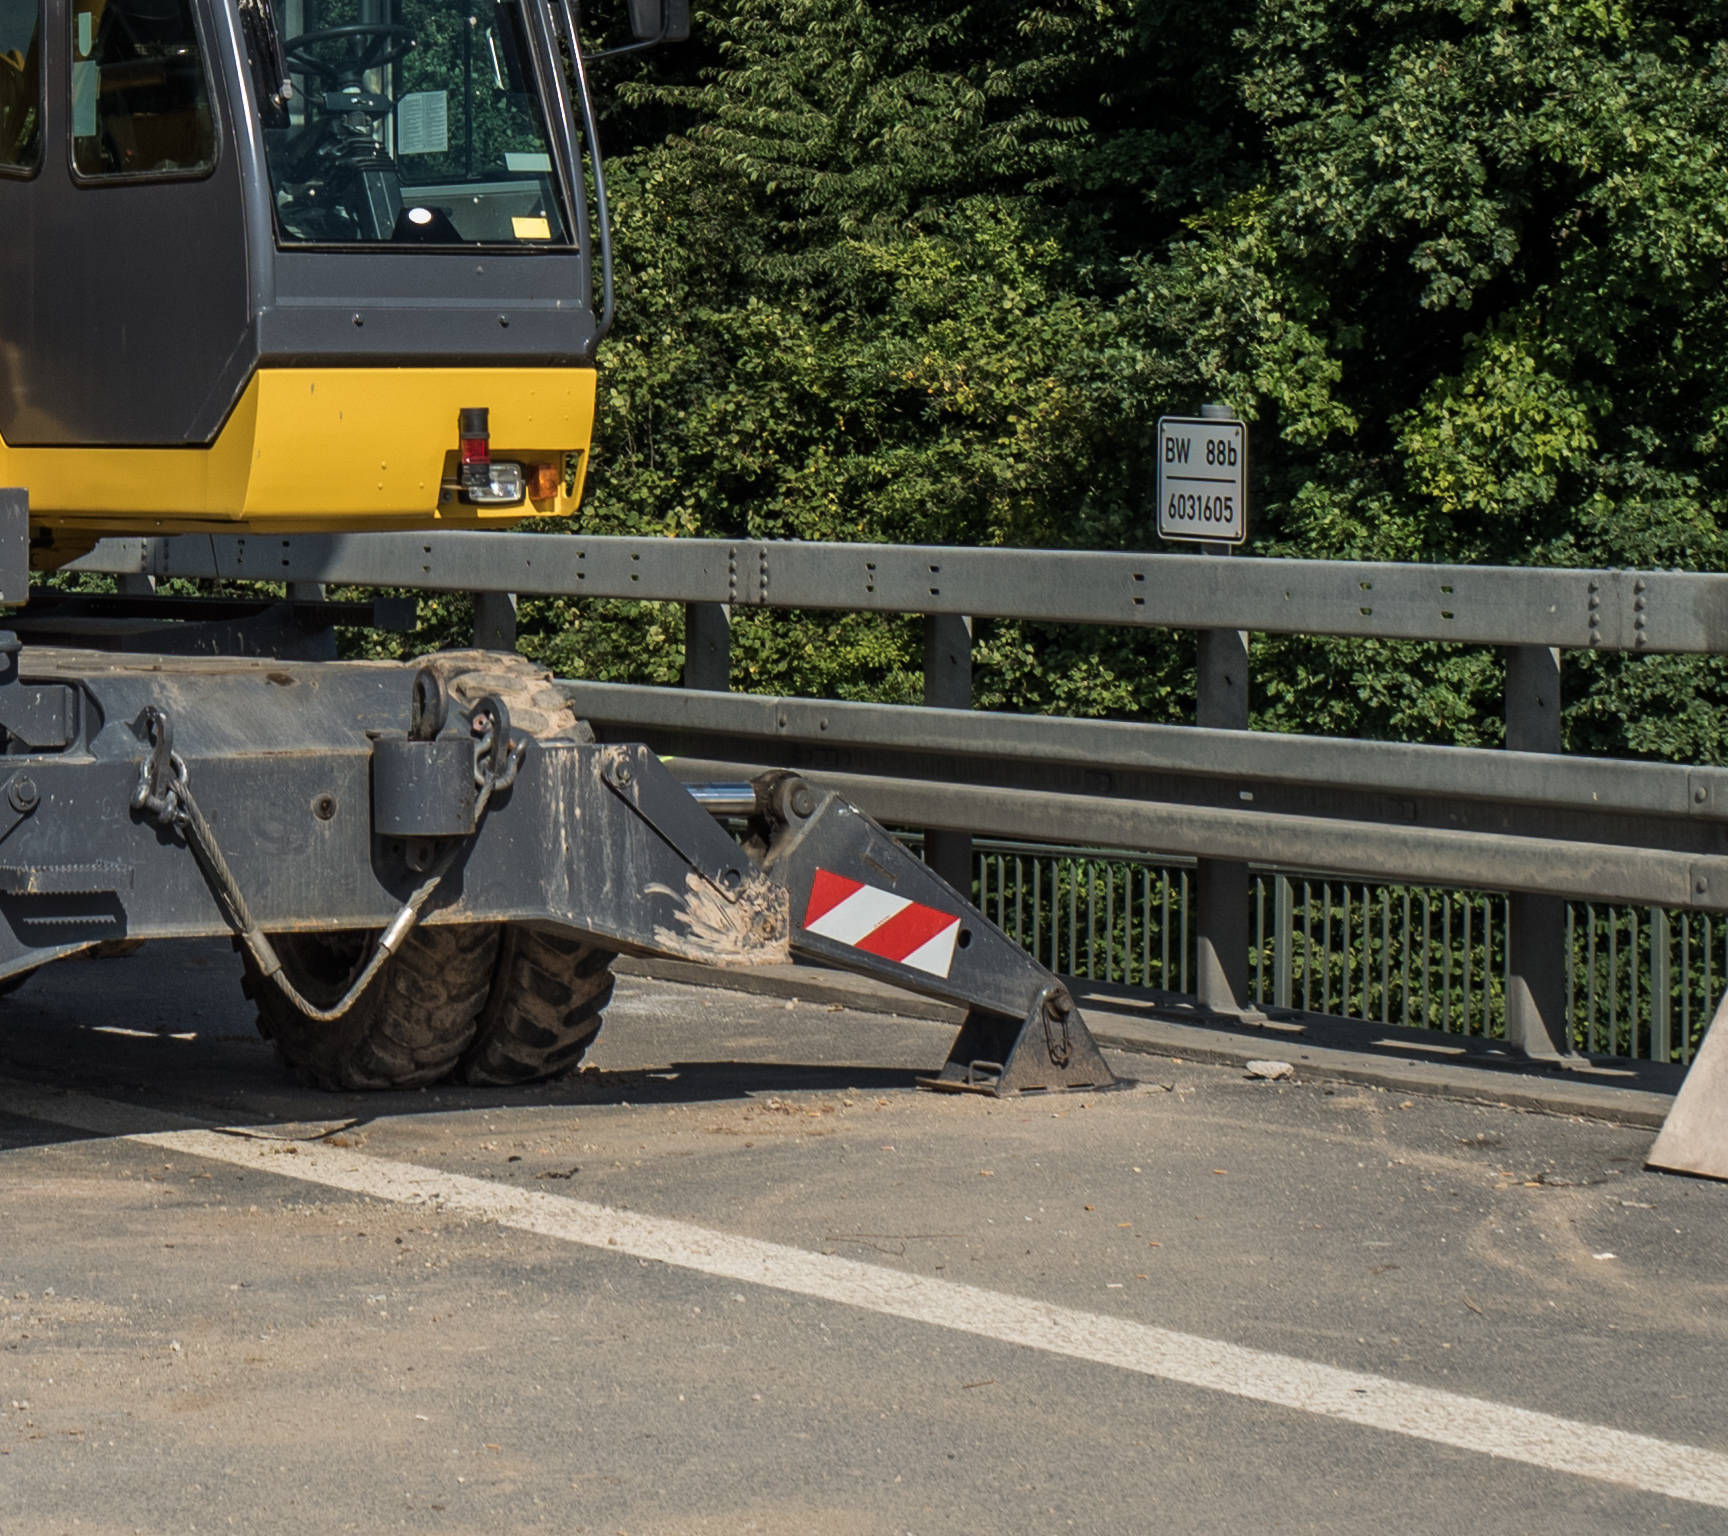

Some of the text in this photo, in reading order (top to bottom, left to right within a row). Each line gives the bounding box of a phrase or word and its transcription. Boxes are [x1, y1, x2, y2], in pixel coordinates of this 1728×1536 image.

[1165, 436, 1238, 467] BW 88b
[1168, 492, 1234, 524] 6031605
